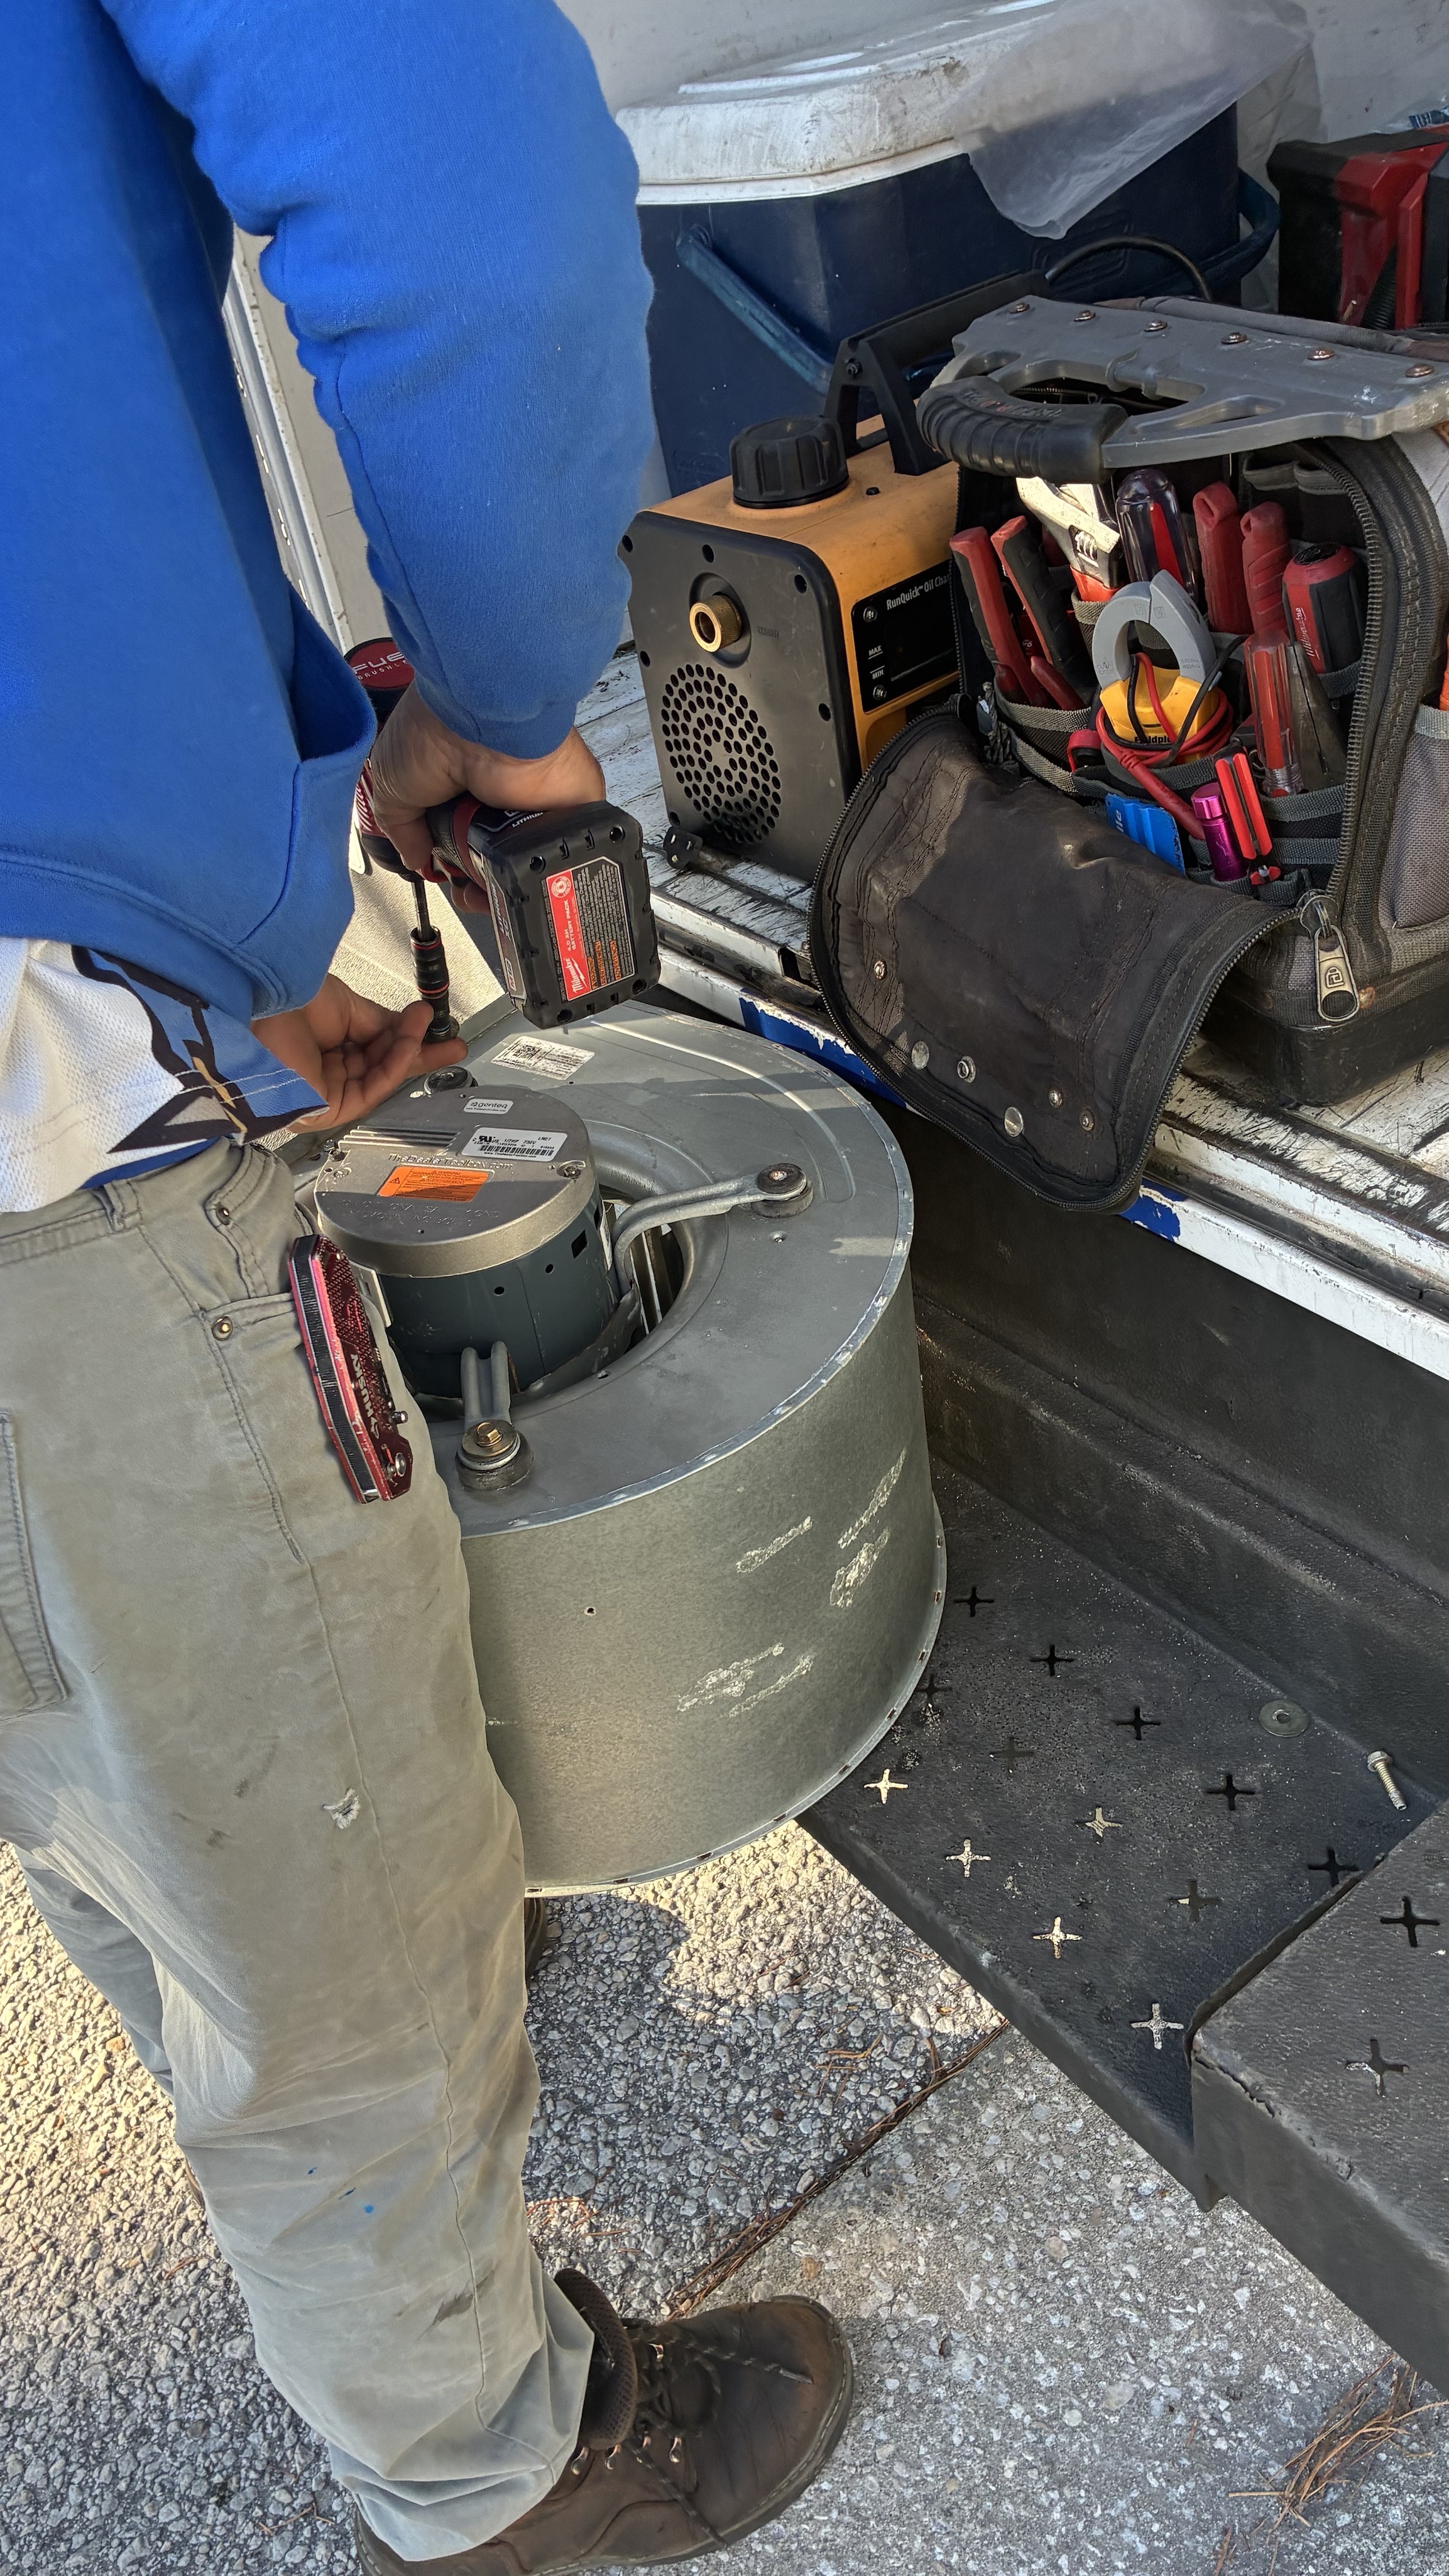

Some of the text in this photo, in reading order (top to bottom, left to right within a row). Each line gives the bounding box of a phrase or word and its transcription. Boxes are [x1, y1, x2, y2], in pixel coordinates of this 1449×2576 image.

[924, 579, 934, 592] Oil
[868, 645, 882, 656] MAX
[872, 669, 884, 680] MIN
[566, 920, 576, 950] BATTERY
[566, 958, 584, 994] Milwaukee
[351, 1354, 374, 1417] HUSKY
